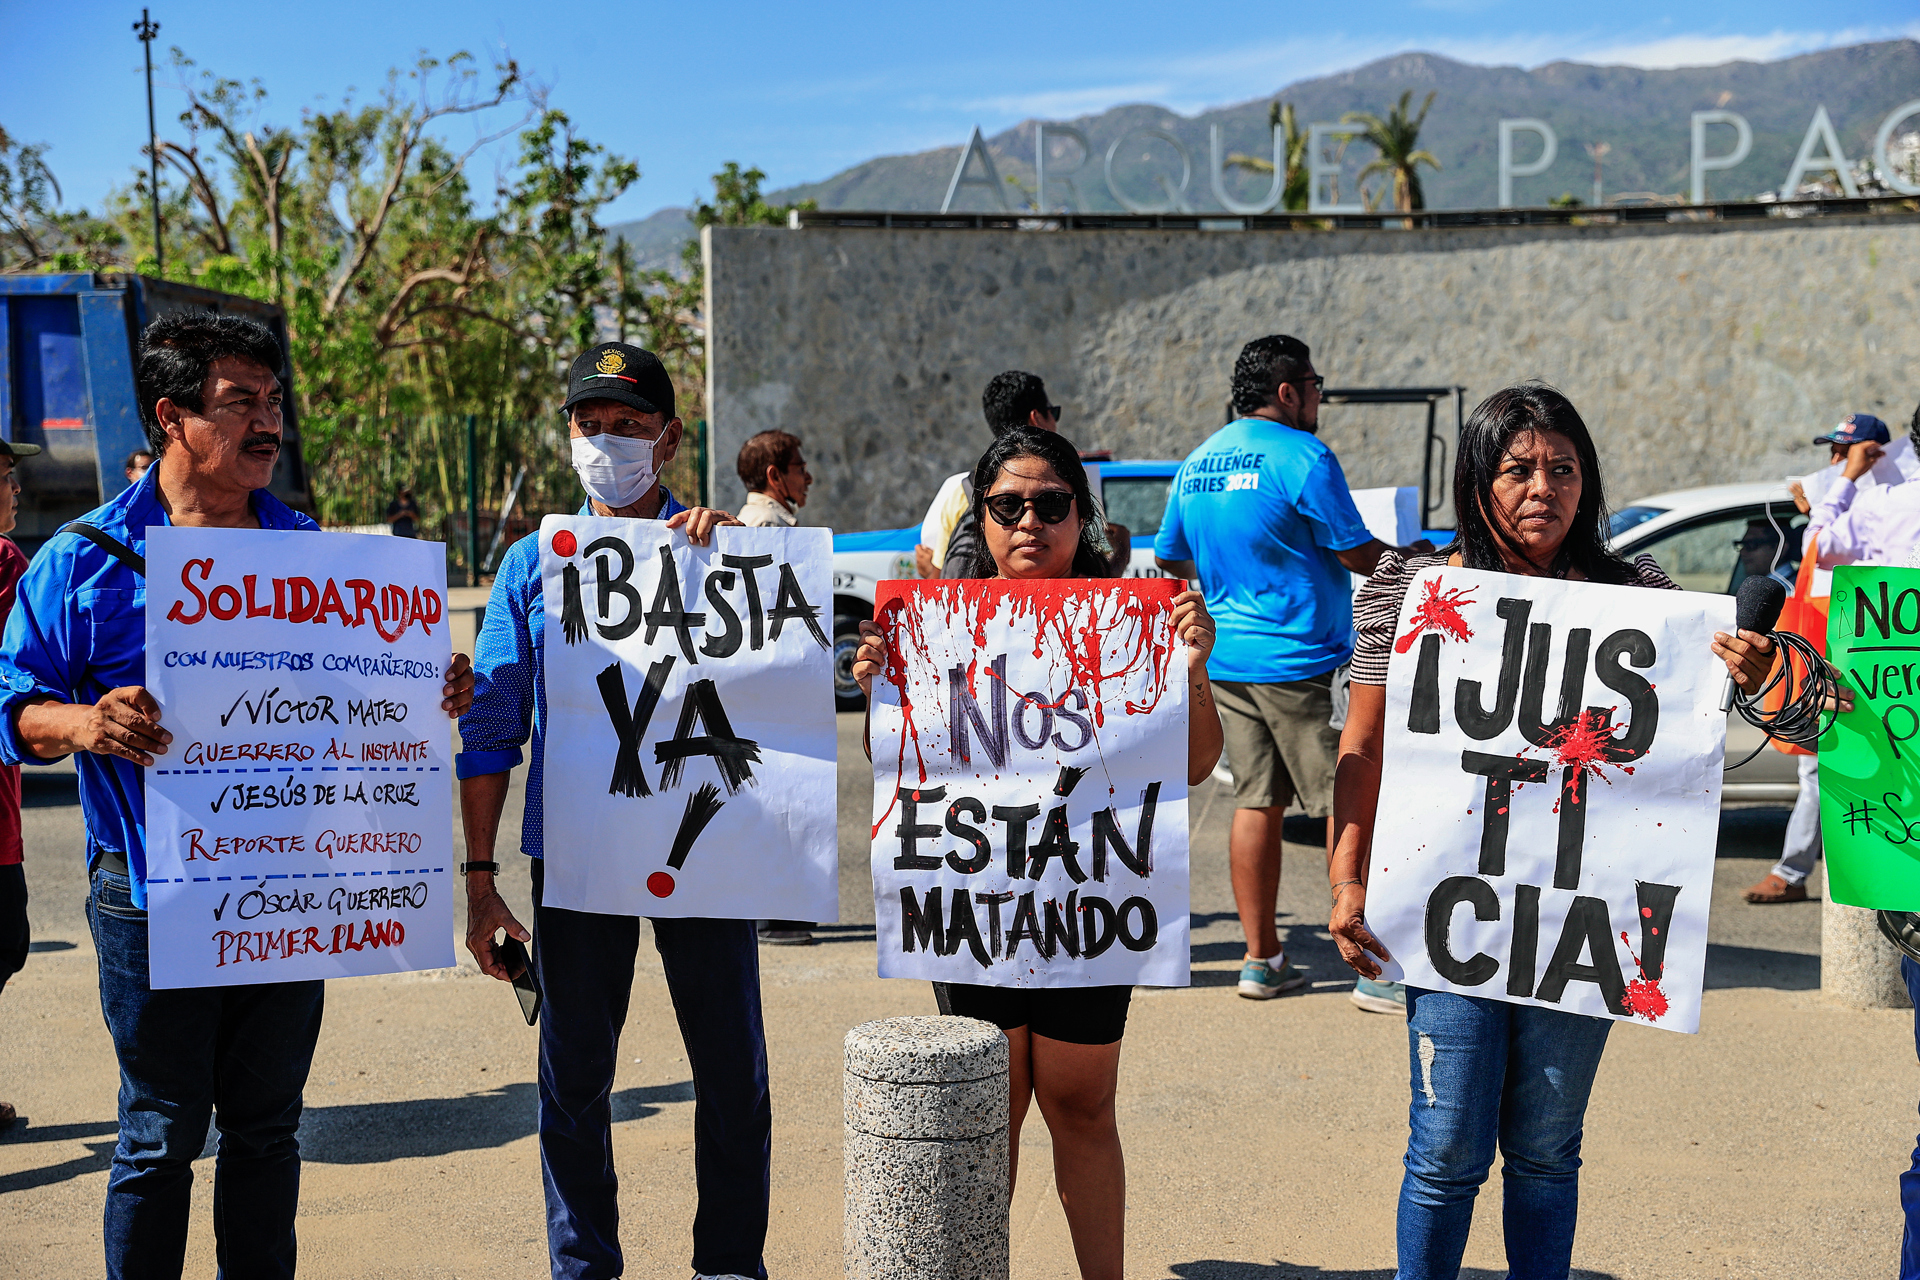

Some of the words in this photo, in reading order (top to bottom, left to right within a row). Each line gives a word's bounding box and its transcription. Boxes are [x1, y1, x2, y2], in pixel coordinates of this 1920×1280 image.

[1182, 476, 1225, 497] SERIES
[1226, 472, 1259, 492] 2021
[1185, 453, 1266, 477] CHALLENGE
[166, 558, 442, 643] SOLIDARIDAD
[551, 529, 832, 664] ¡BASTA
[164, 651, 207, 668] CON
[212, 651, 314, 672] NUESTROS
[322, 652, 440, 679] COMPAÑEROS:
[1849, 663, 1920, 700] ver
[245, 687, 340, 725] VÍCTOR
[348, 698, 408, 727] MATEO
[596, 655, 763, 798] YA
[184, 742, 314, 766] GUERRERO
[323, 737, 355, 760] AL
[361, 740, 430, 763] INSTANTE
[232, 775, 307, 812] JESÚS
[313, 785, 336, 806] DE
[343, 781, 368, 806] LA
[372, 782, 420, 806] CRUZ
[894, 766, 1162, 884] ESTÁN
[1461, 750, 1588, 890] TI
[181, 828, 305, 862] REPORTE
[315, 829, 423, 860] GUERRERO
[237, 880, 322, 920] ÓSCAR
[327, 881, 428, 916] GUERRERO
[212, 926, 328, 968] PRIMER
[328, 918, 405, 956] PLANO
[899, 886, 1158, 970] MATANDO
[1424, 875, 1683, 1022] CIA!
